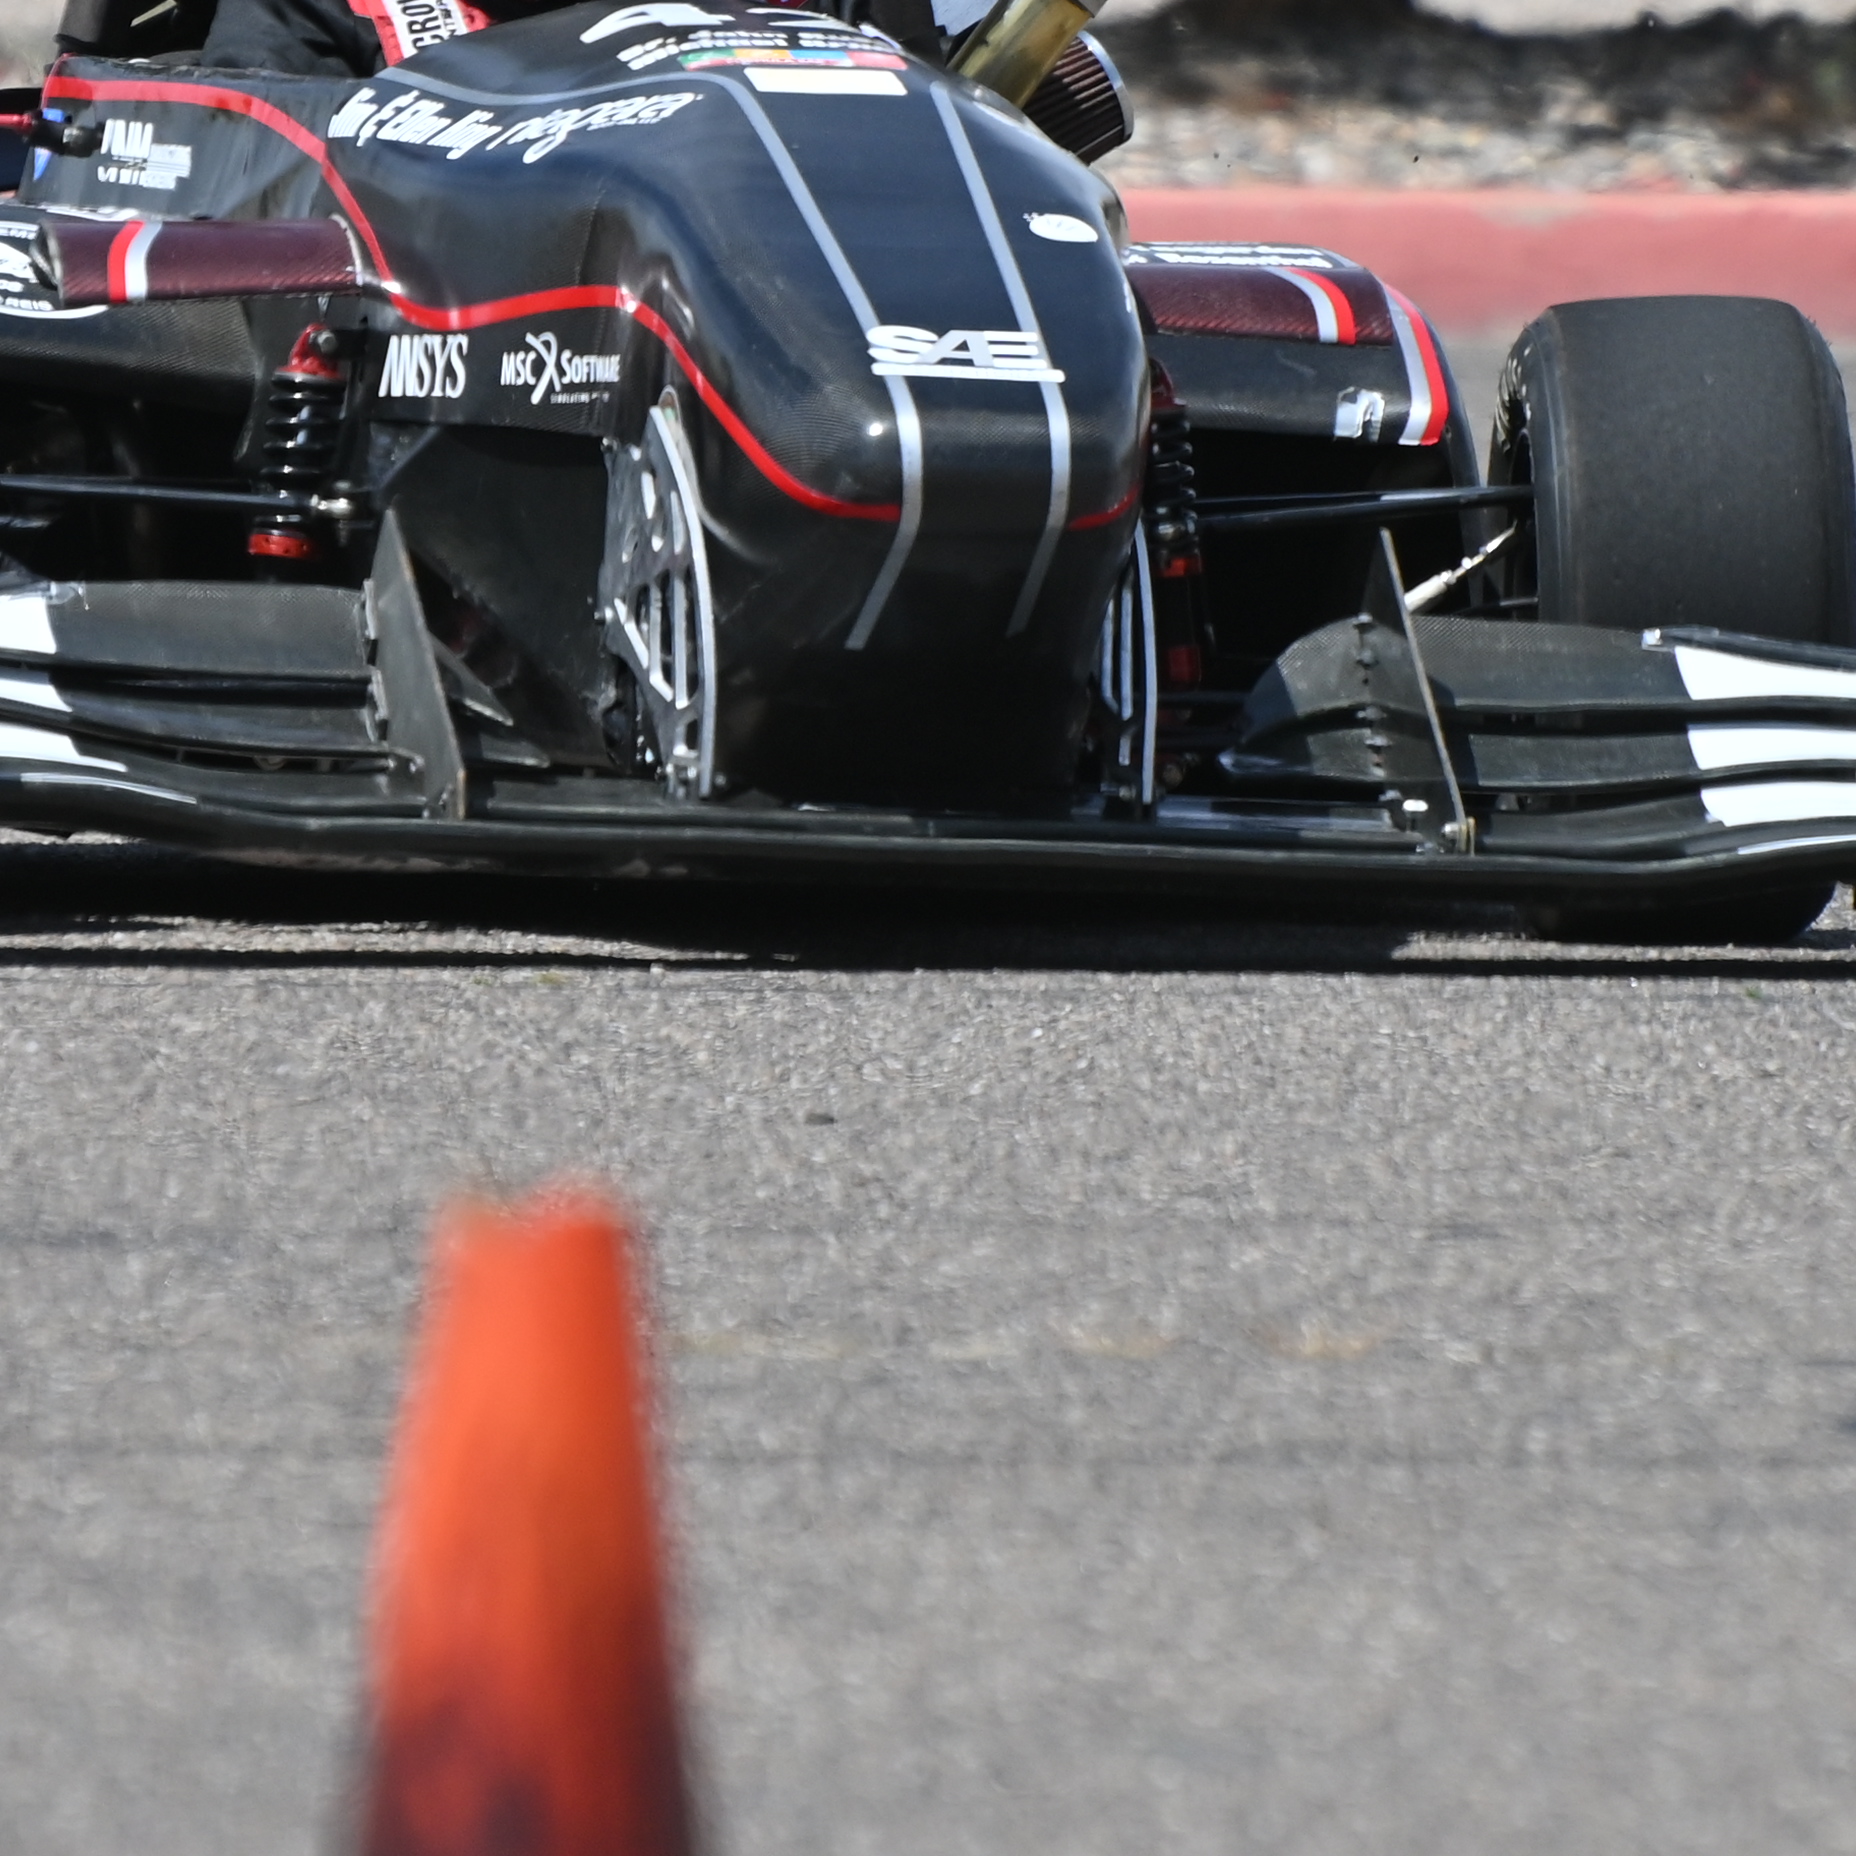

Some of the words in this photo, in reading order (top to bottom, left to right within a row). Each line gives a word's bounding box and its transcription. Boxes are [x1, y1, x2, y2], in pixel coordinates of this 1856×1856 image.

[377, 333, 470, 400] ANSYS
[500, 350, 537, 386] MSC
[865, 324, 1049, 370] SAE
